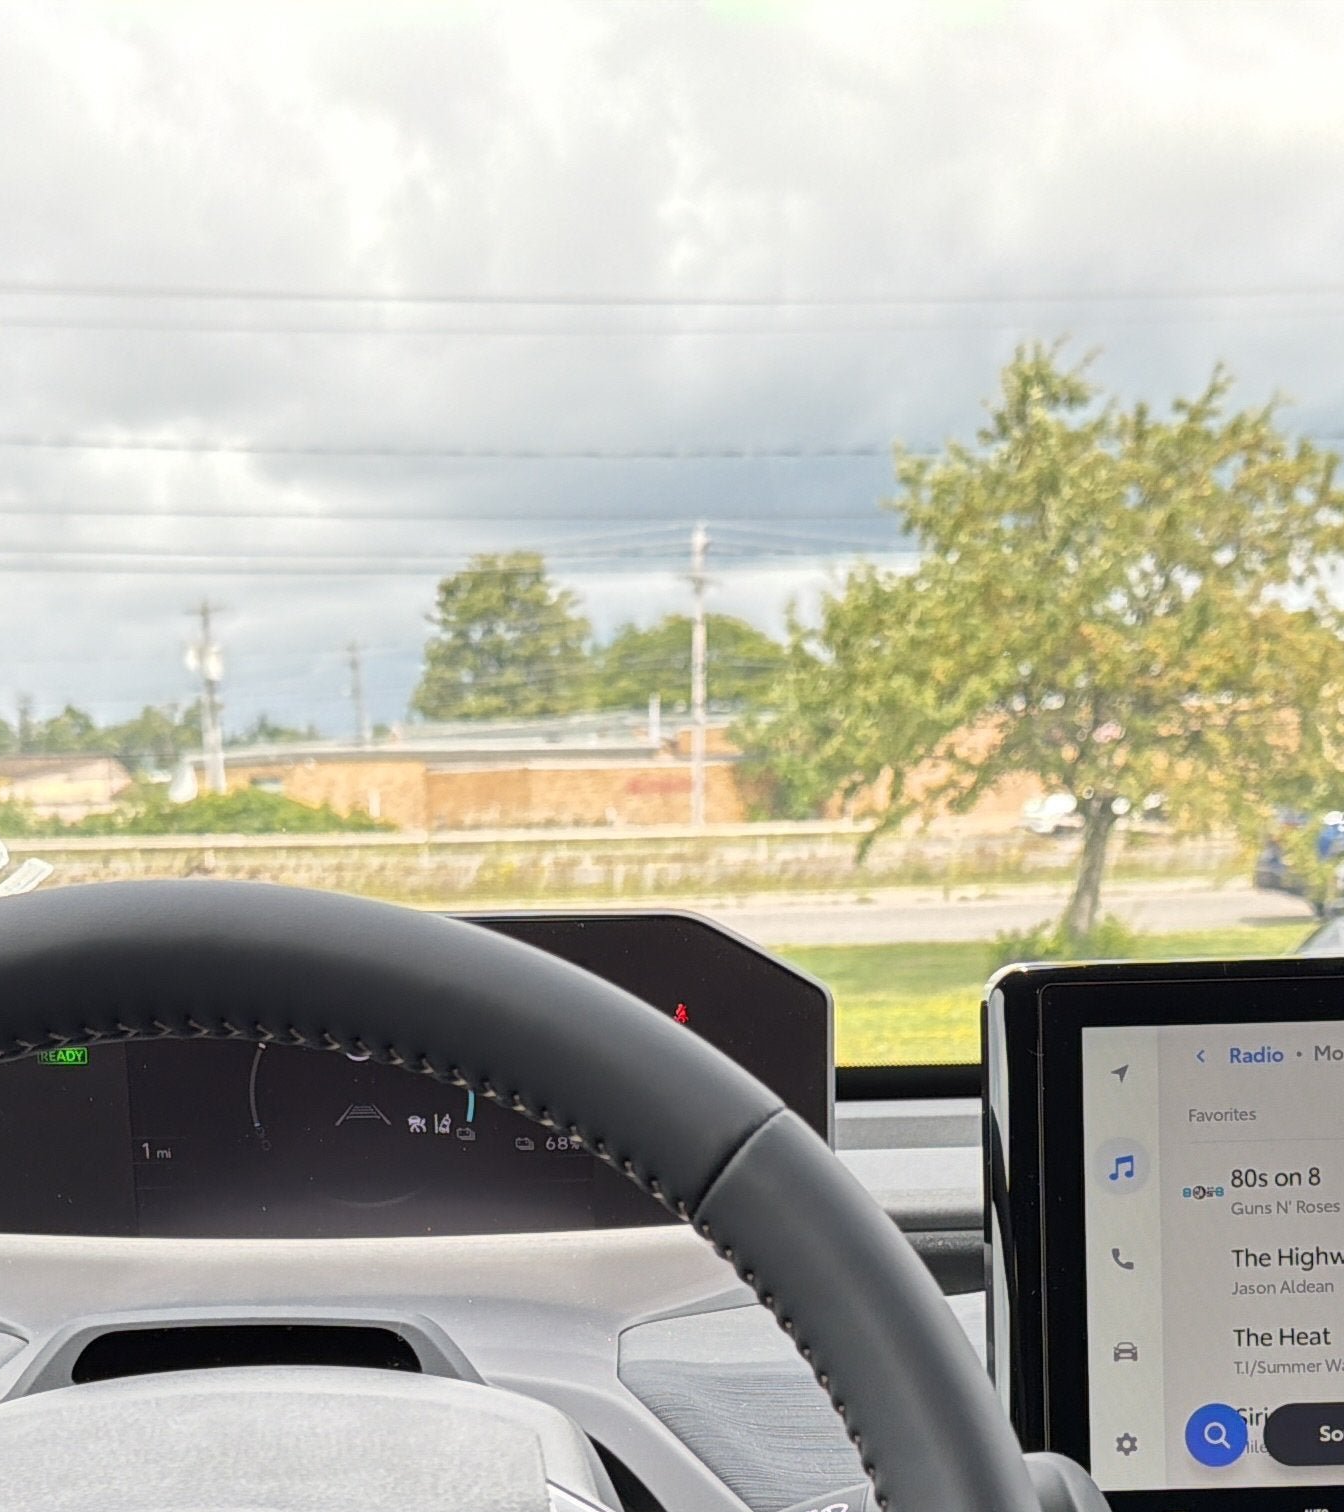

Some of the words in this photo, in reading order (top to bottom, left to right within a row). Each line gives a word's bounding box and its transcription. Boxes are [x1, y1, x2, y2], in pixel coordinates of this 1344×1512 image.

[39, 1049, 85, 1064] READY
[1229, 1047, 1284, 1064] Radio
[1188, 1107, 1256, 1123] Favorites
[141, 1142, 151, 1159] 1
[156, 1147, 172, 1159] mi
[1231, 1168, 1269, 1189] 80s
[1274, 1171, 1303, 1187] on
[1308, 1167, 1321, 1187] 8
[1231, 1200, 1272, 1216] Guns
[1297, 1199, 1341, 1214] Roses
[1232, 1248, 1271, 1268] The
[1231, 1280, 1276, 1296] Jason
[1280, 1279, 1335, 1294] Aldean
[1233, 1328, 1273, 1348] The
[1279, 1327, 1332, 1347] Heat
